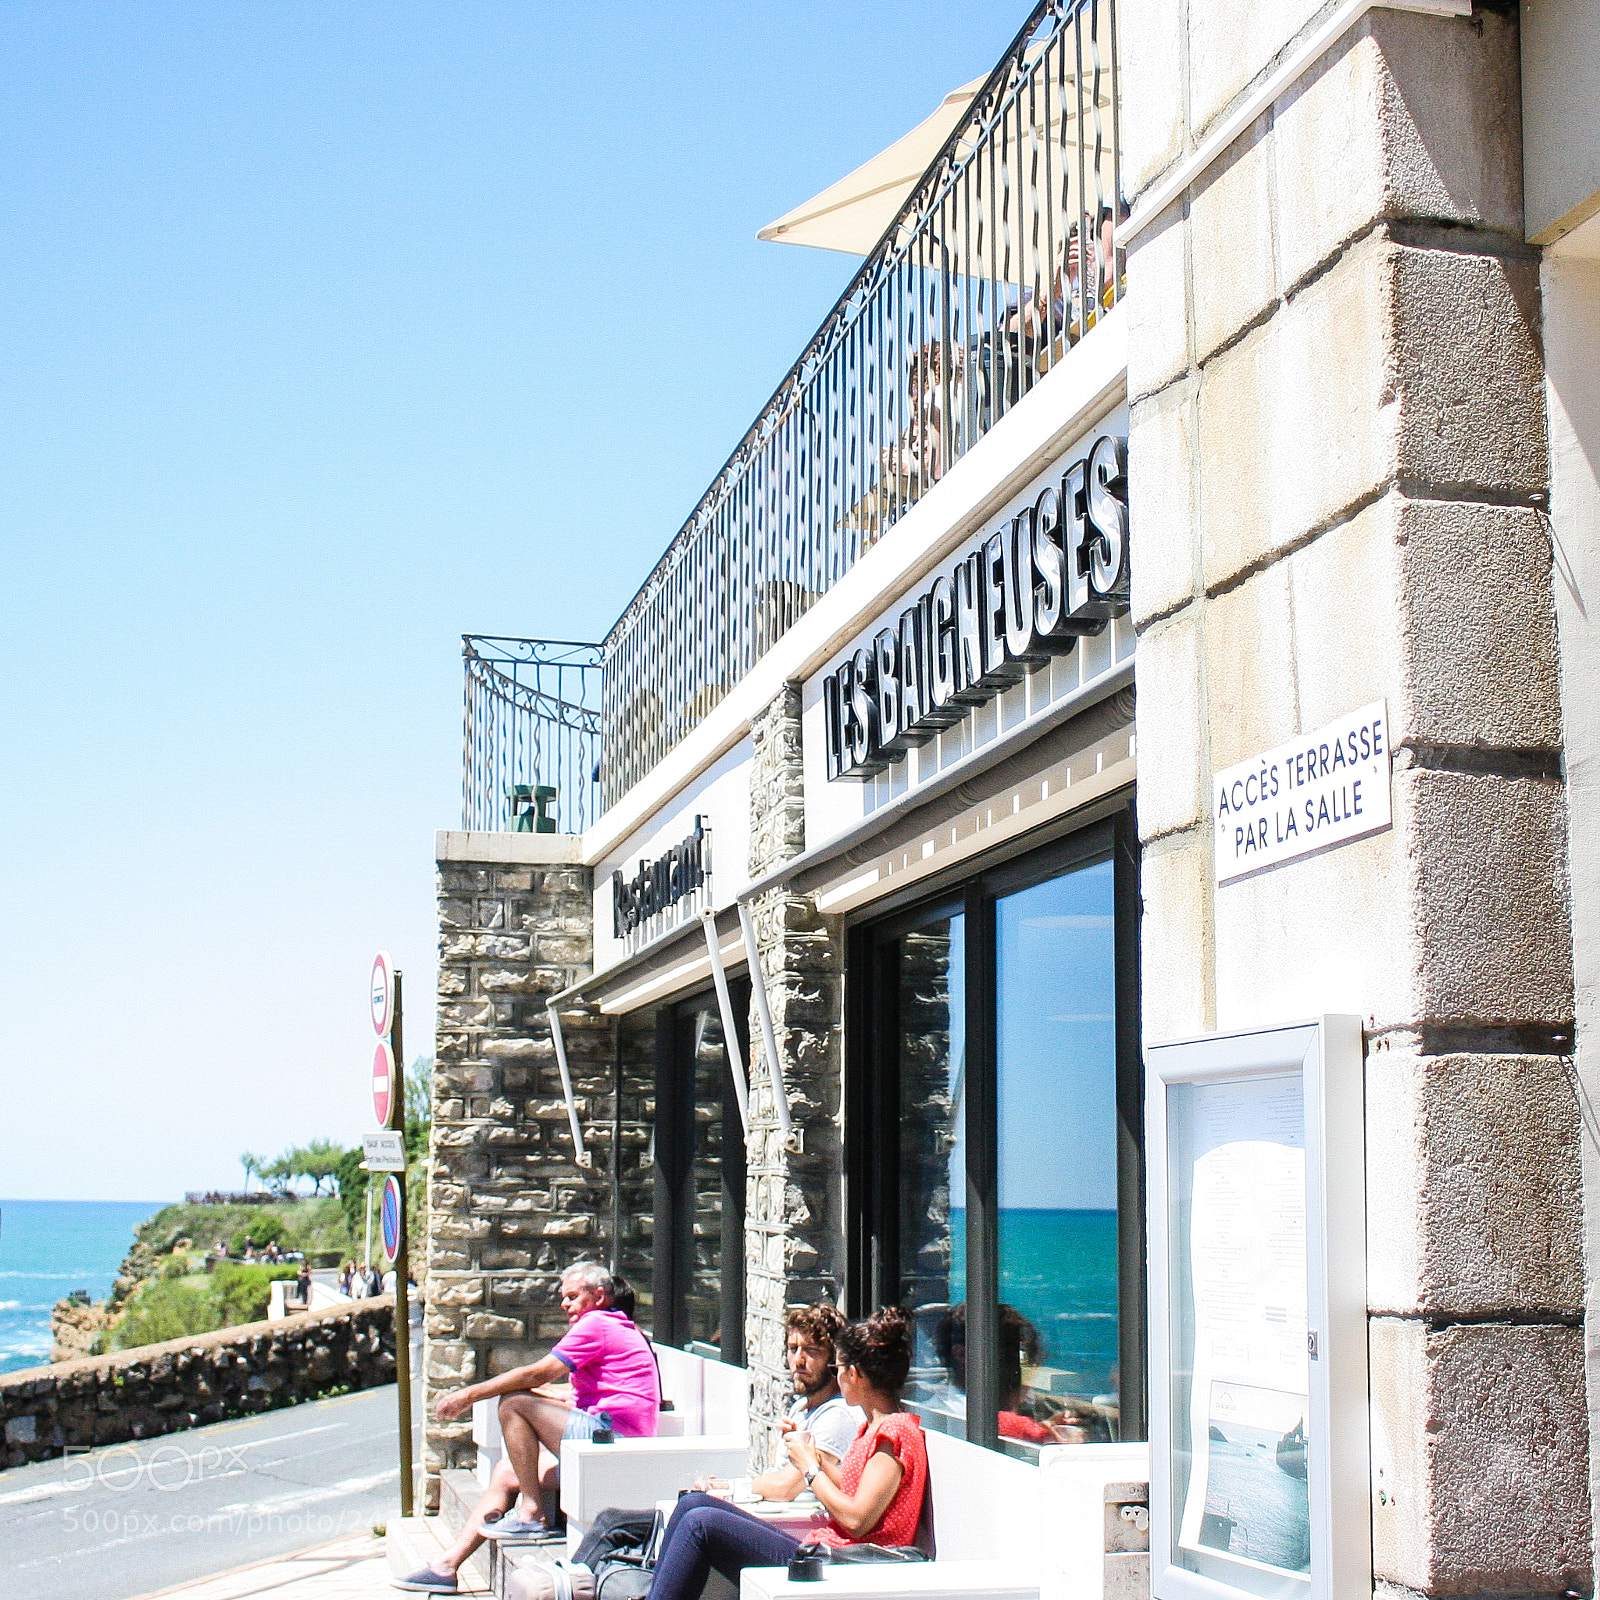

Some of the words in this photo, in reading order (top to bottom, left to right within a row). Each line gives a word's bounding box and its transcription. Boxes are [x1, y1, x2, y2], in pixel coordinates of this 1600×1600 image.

[823, 648, 877, 782] LES
[873, 434, 1129, 749] BAIGNEUSES
[1218, 759, 1279, 819] ACCÈS
[1285, 719, 1383, 790] TERRASSE
[1234, 817, 1269, 858] PAR
[1276, 806, 1299, 844] LA
[1304, 780, 1364, 833] SALLE
